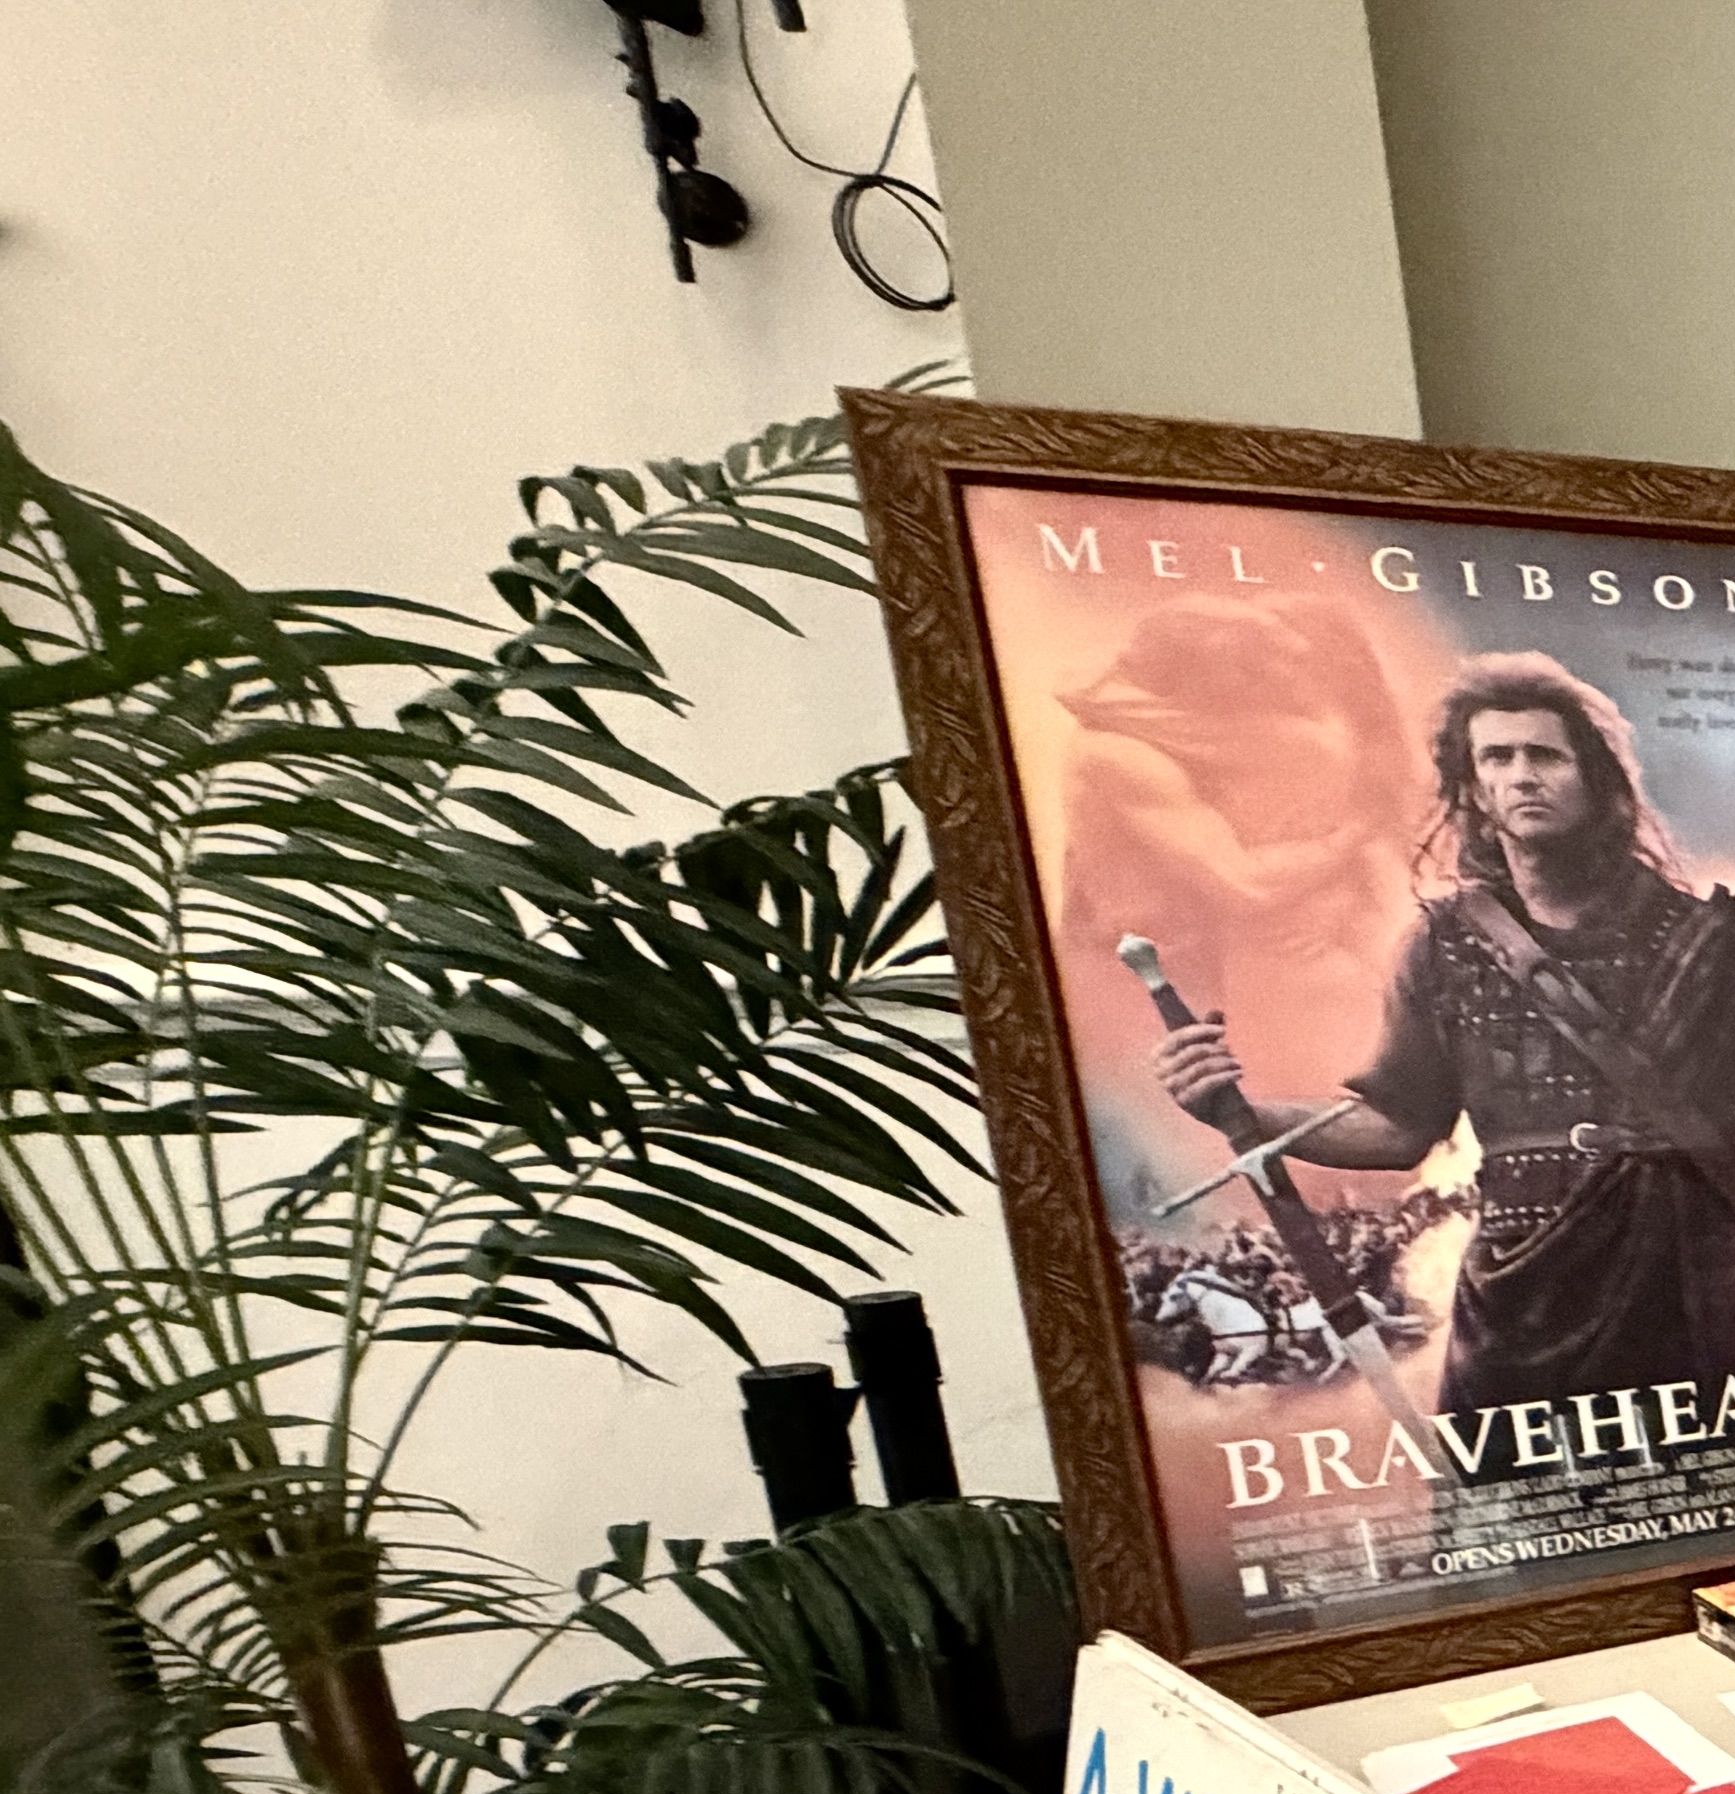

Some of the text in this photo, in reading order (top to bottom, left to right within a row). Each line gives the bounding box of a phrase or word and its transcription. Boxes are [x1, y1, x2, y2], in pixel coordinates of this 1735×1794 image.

[1037, 524, 1265, 585] MEL
[1432, 1539, 1516, 1577] OPENS
[1514, 1516, 1669, 1562] WEDNESDAY,
[1668, 1508, 1721, 1537] MAY
